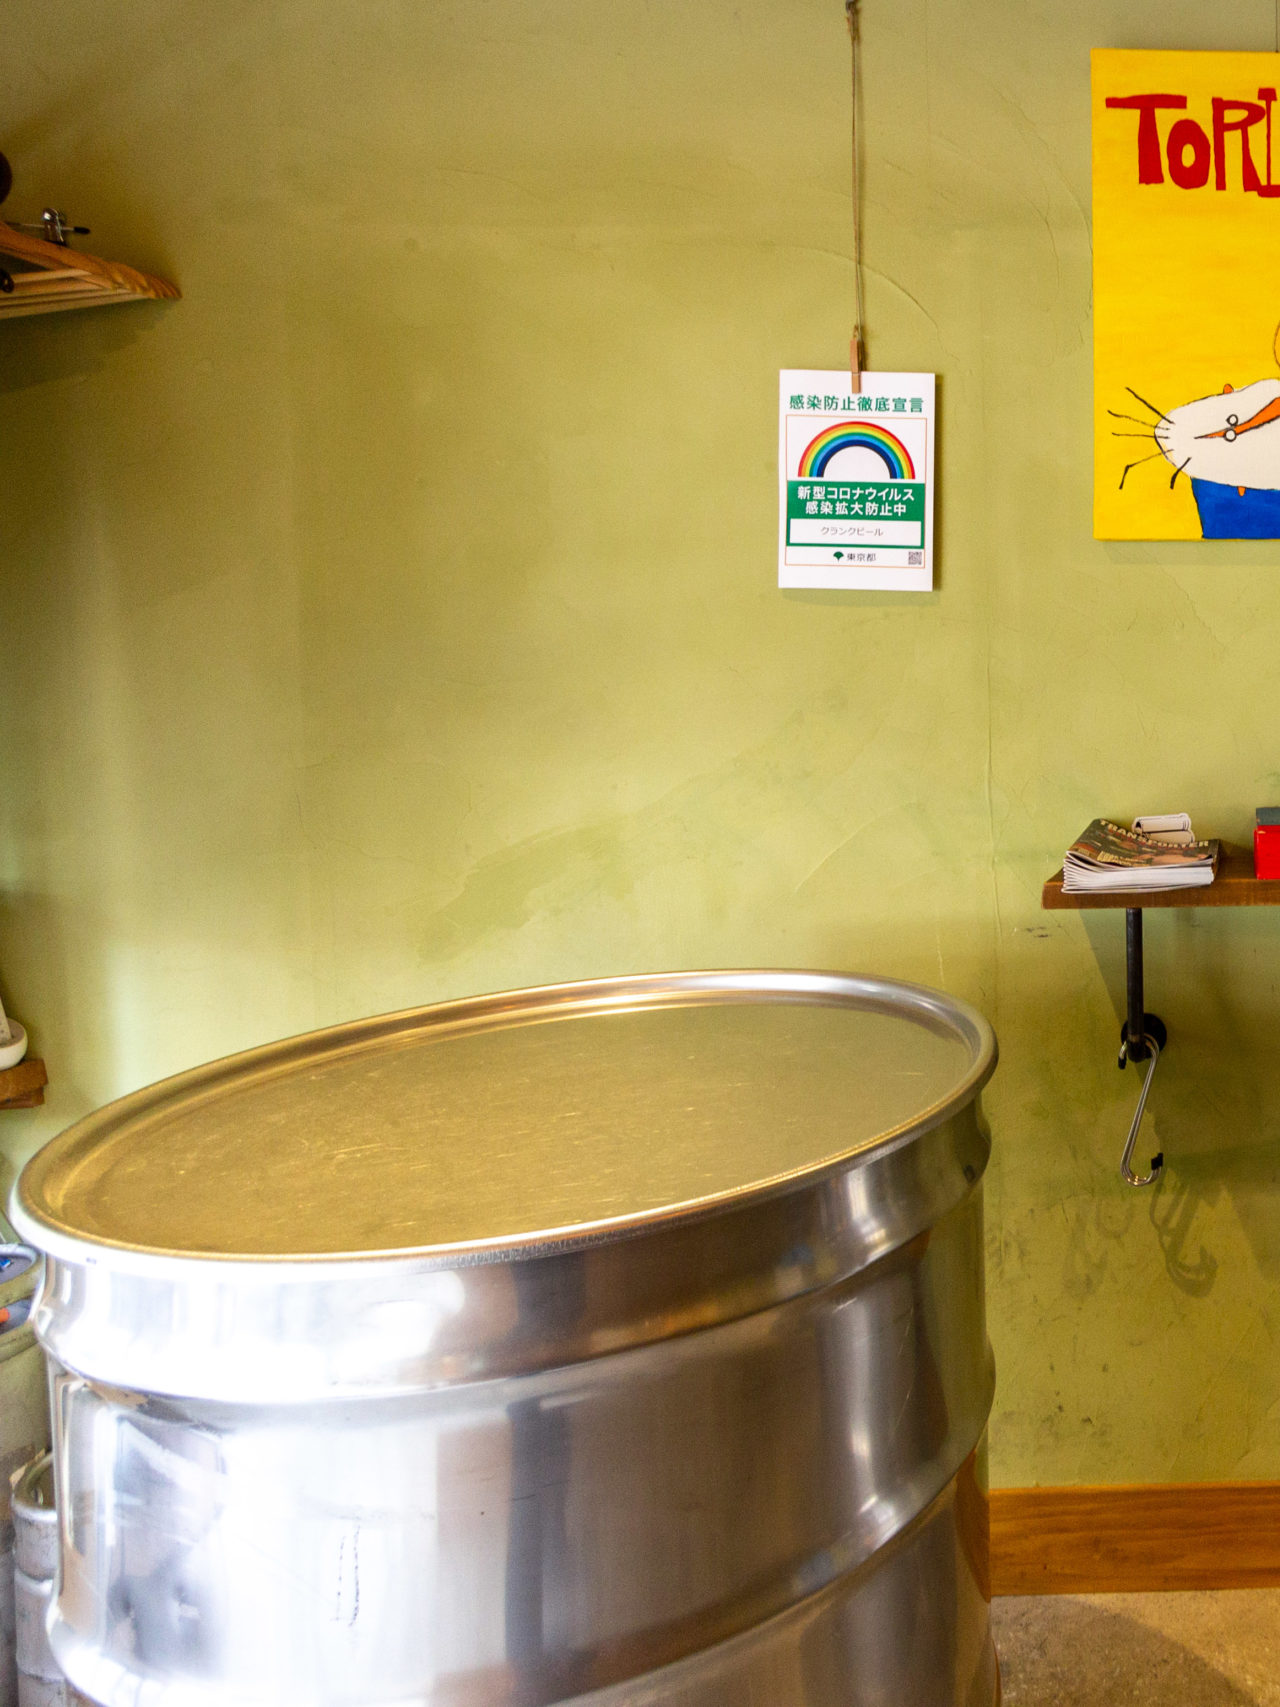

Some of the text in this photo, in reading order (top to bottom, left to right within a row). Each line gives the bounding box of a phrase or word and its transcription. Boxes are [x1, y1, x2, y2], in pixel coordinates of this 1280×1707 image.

[789, 395, 924, 413] 感染防止徹底宣言
[797, 485, 915, 501] 新型コロナウイルス
[805, 501, 907, 516] 感染拡大防止中
[820, 526, 884, 537] クランクビール
[846, 552, 877, 562] 東京都
